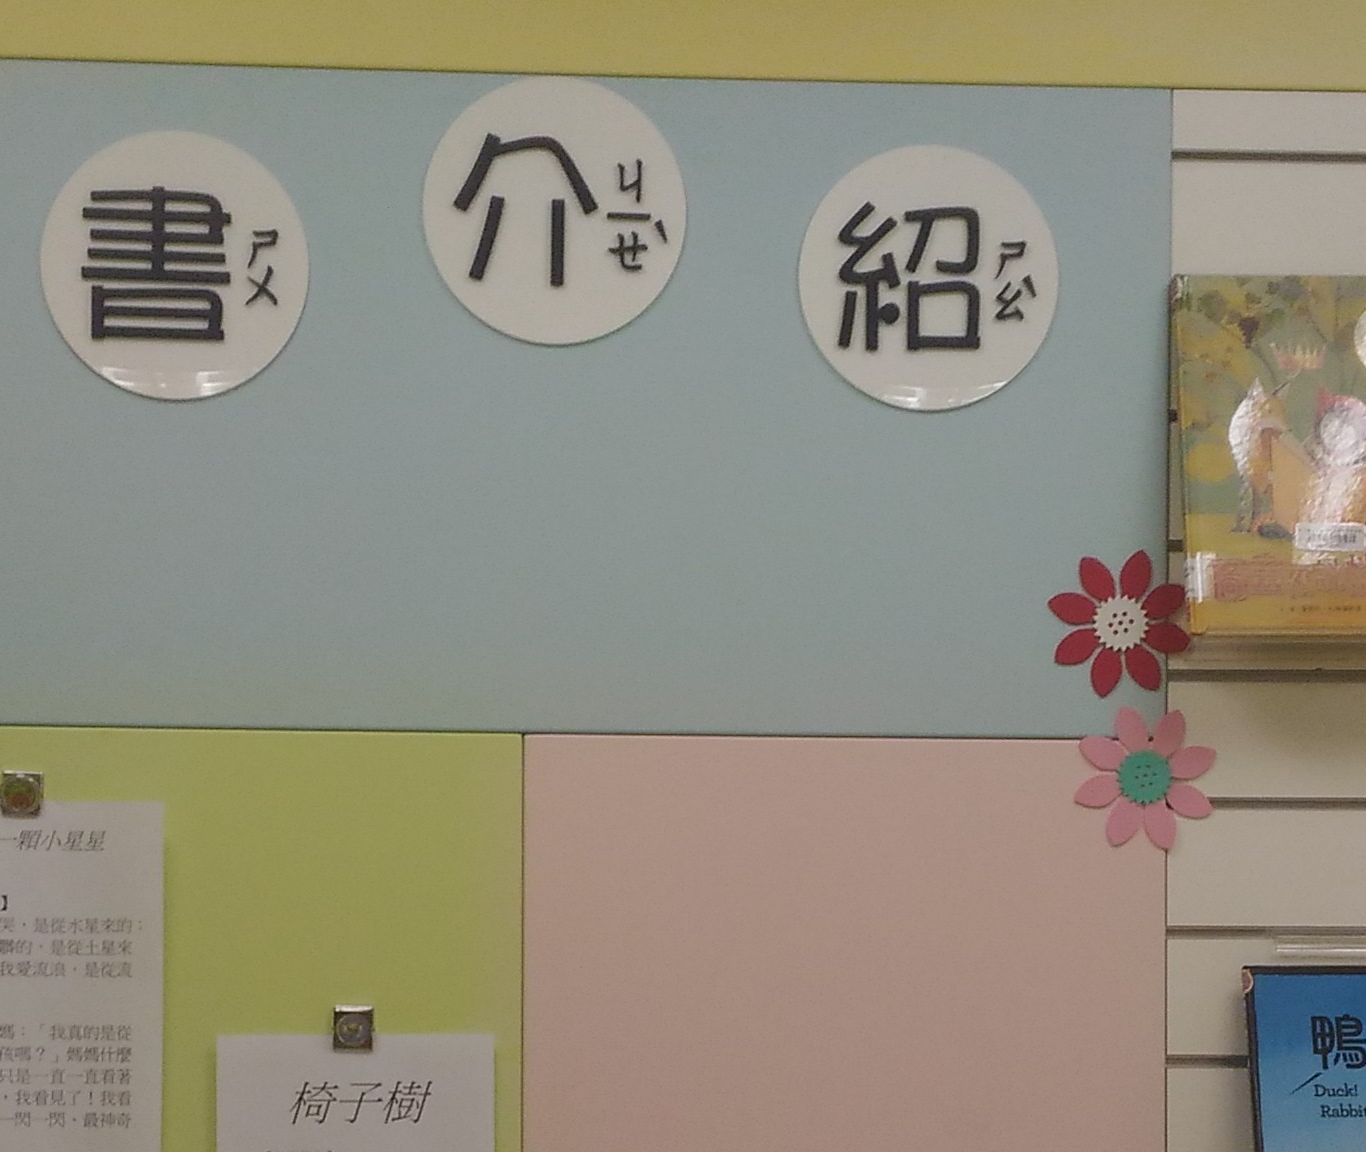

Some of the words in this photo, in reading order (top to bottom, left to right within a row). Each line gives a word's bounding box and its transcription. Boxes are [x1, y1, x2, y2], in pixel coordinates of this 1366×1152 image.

[289, 1080, 433, 1125] 椅子樹
[1314, 1084, 1359, 1097] Duck!
